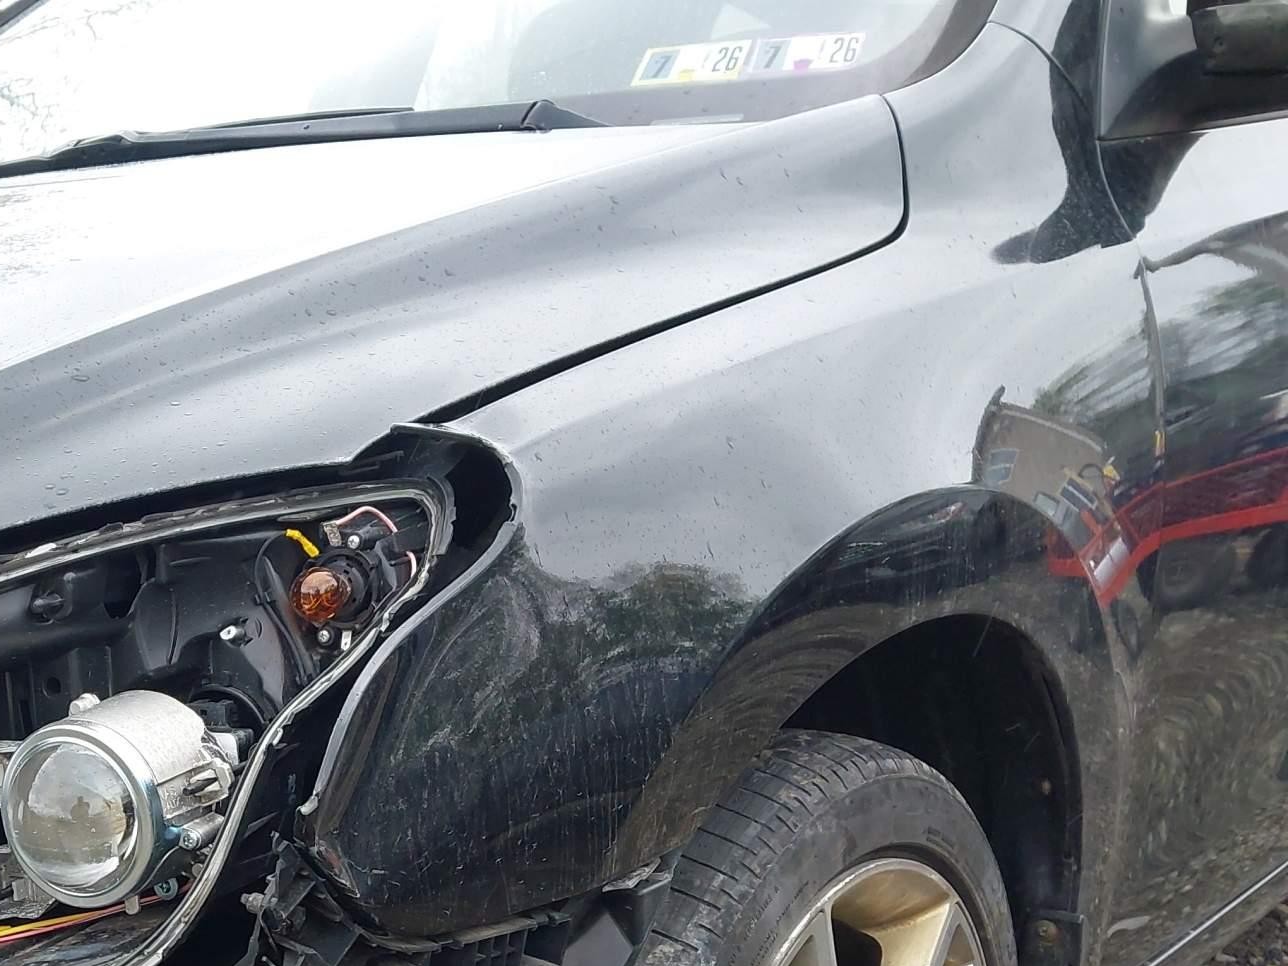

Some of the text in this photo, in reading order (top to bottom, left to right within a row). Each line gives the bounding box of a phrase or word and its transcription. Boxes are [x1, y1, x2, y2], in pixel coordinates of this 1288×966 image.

[654, 46, 744, 79] 7 26
[763, 36, 861, 69] 7 26
